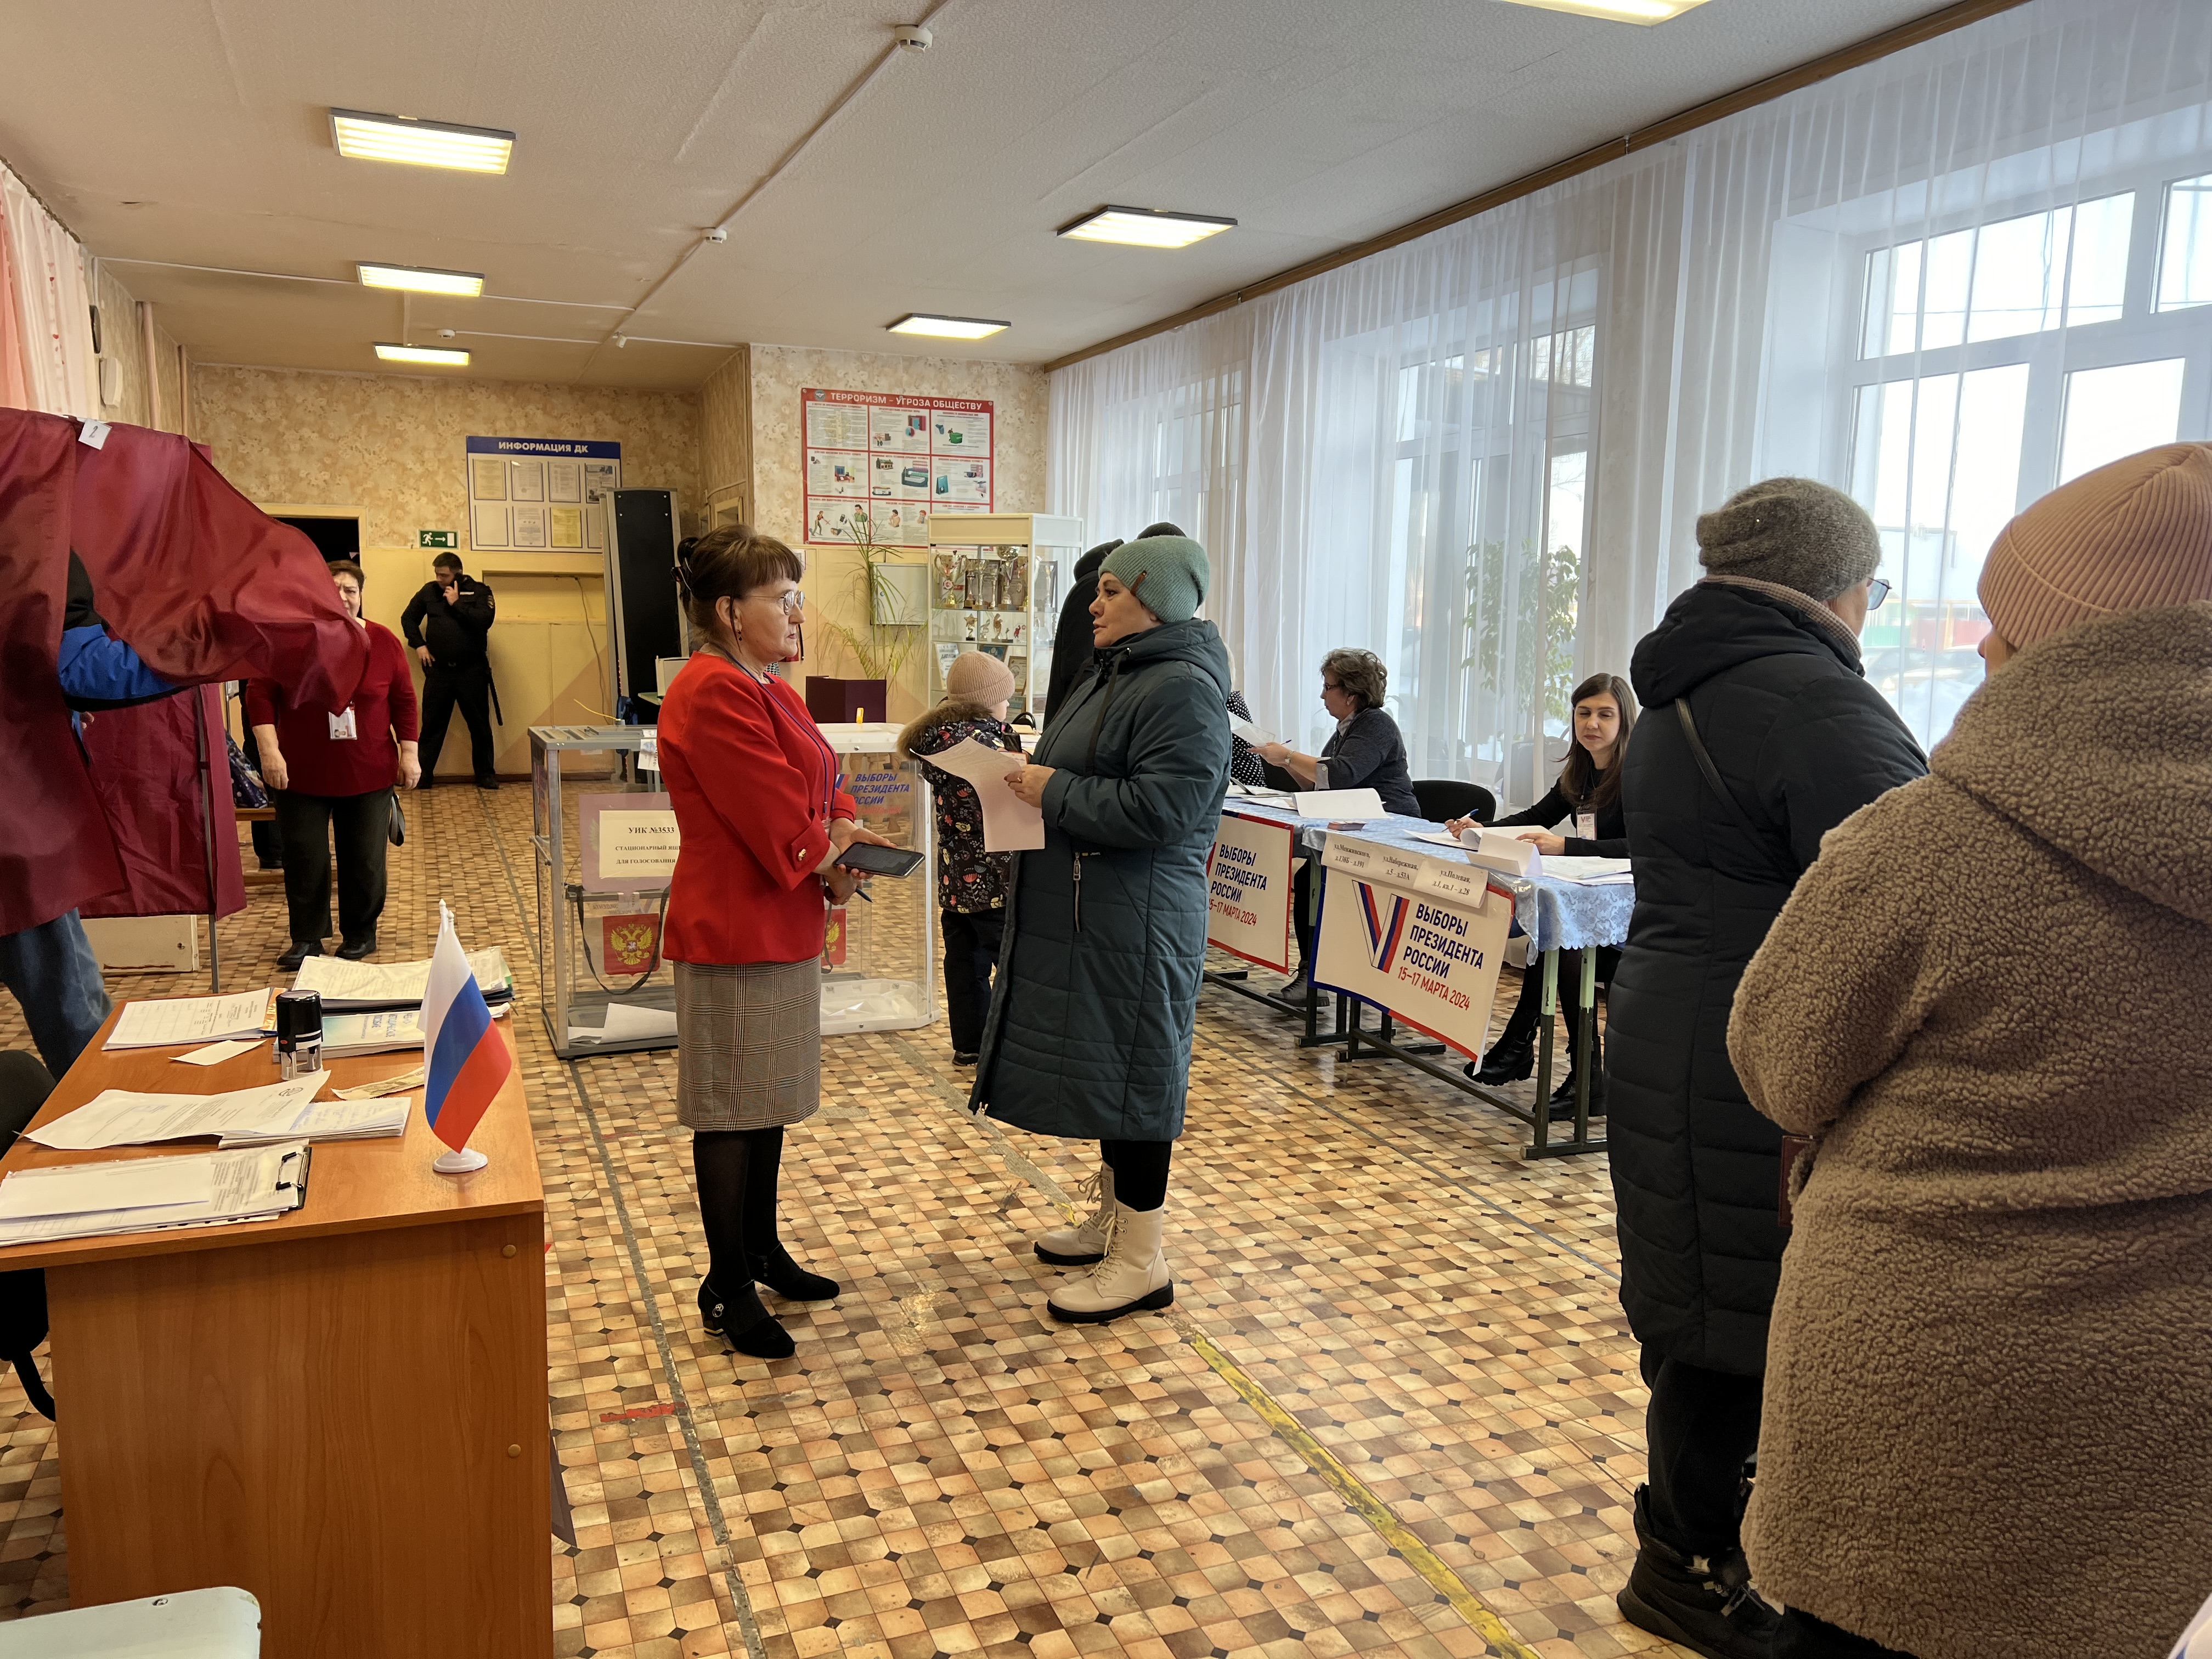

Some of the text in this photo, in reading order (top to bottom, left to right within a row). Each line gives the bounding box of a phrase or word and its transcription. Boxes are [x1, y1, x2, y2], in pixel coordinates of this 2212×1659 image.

[831, 392, 887, 404] ТЕРРОРИЗМ
[896, 397, 930, 407] УГРОЗА
[933, 400, 982, 410] ОБЩЕСТВУ
[89, 426, 98, 438] 2
[498, 442, 589, 453] ИНФОРМАЦИЯ ДК
[855, 772, 898, 782] ВЫБОРЫ
[850, 784, 910, 794] ПРЕЗИДЕНТА
[855, 795, 884, 805] ОССИИ
[1219, 844, 1257, 866] ВЫБОРЫ
[1215, 862, 1267, 890] ПРЕЗИДЕНТА
[1210, 881, 1242, 902] РОССИИ
[1223, 904, 1241, 921] МАРТА
[1240, 911, 1257, 926] 2024
[1415, 903, 1469, 937] ВЫБОРЫ
[1410, 924, 1484, 969] ПРЕЗИДЕНТА
[1403, 946, 1451, 979] РОССИИ
[1420, 975, 1449, 1001] МАРТА
[1449, 989, 1470, 1011] 2024
